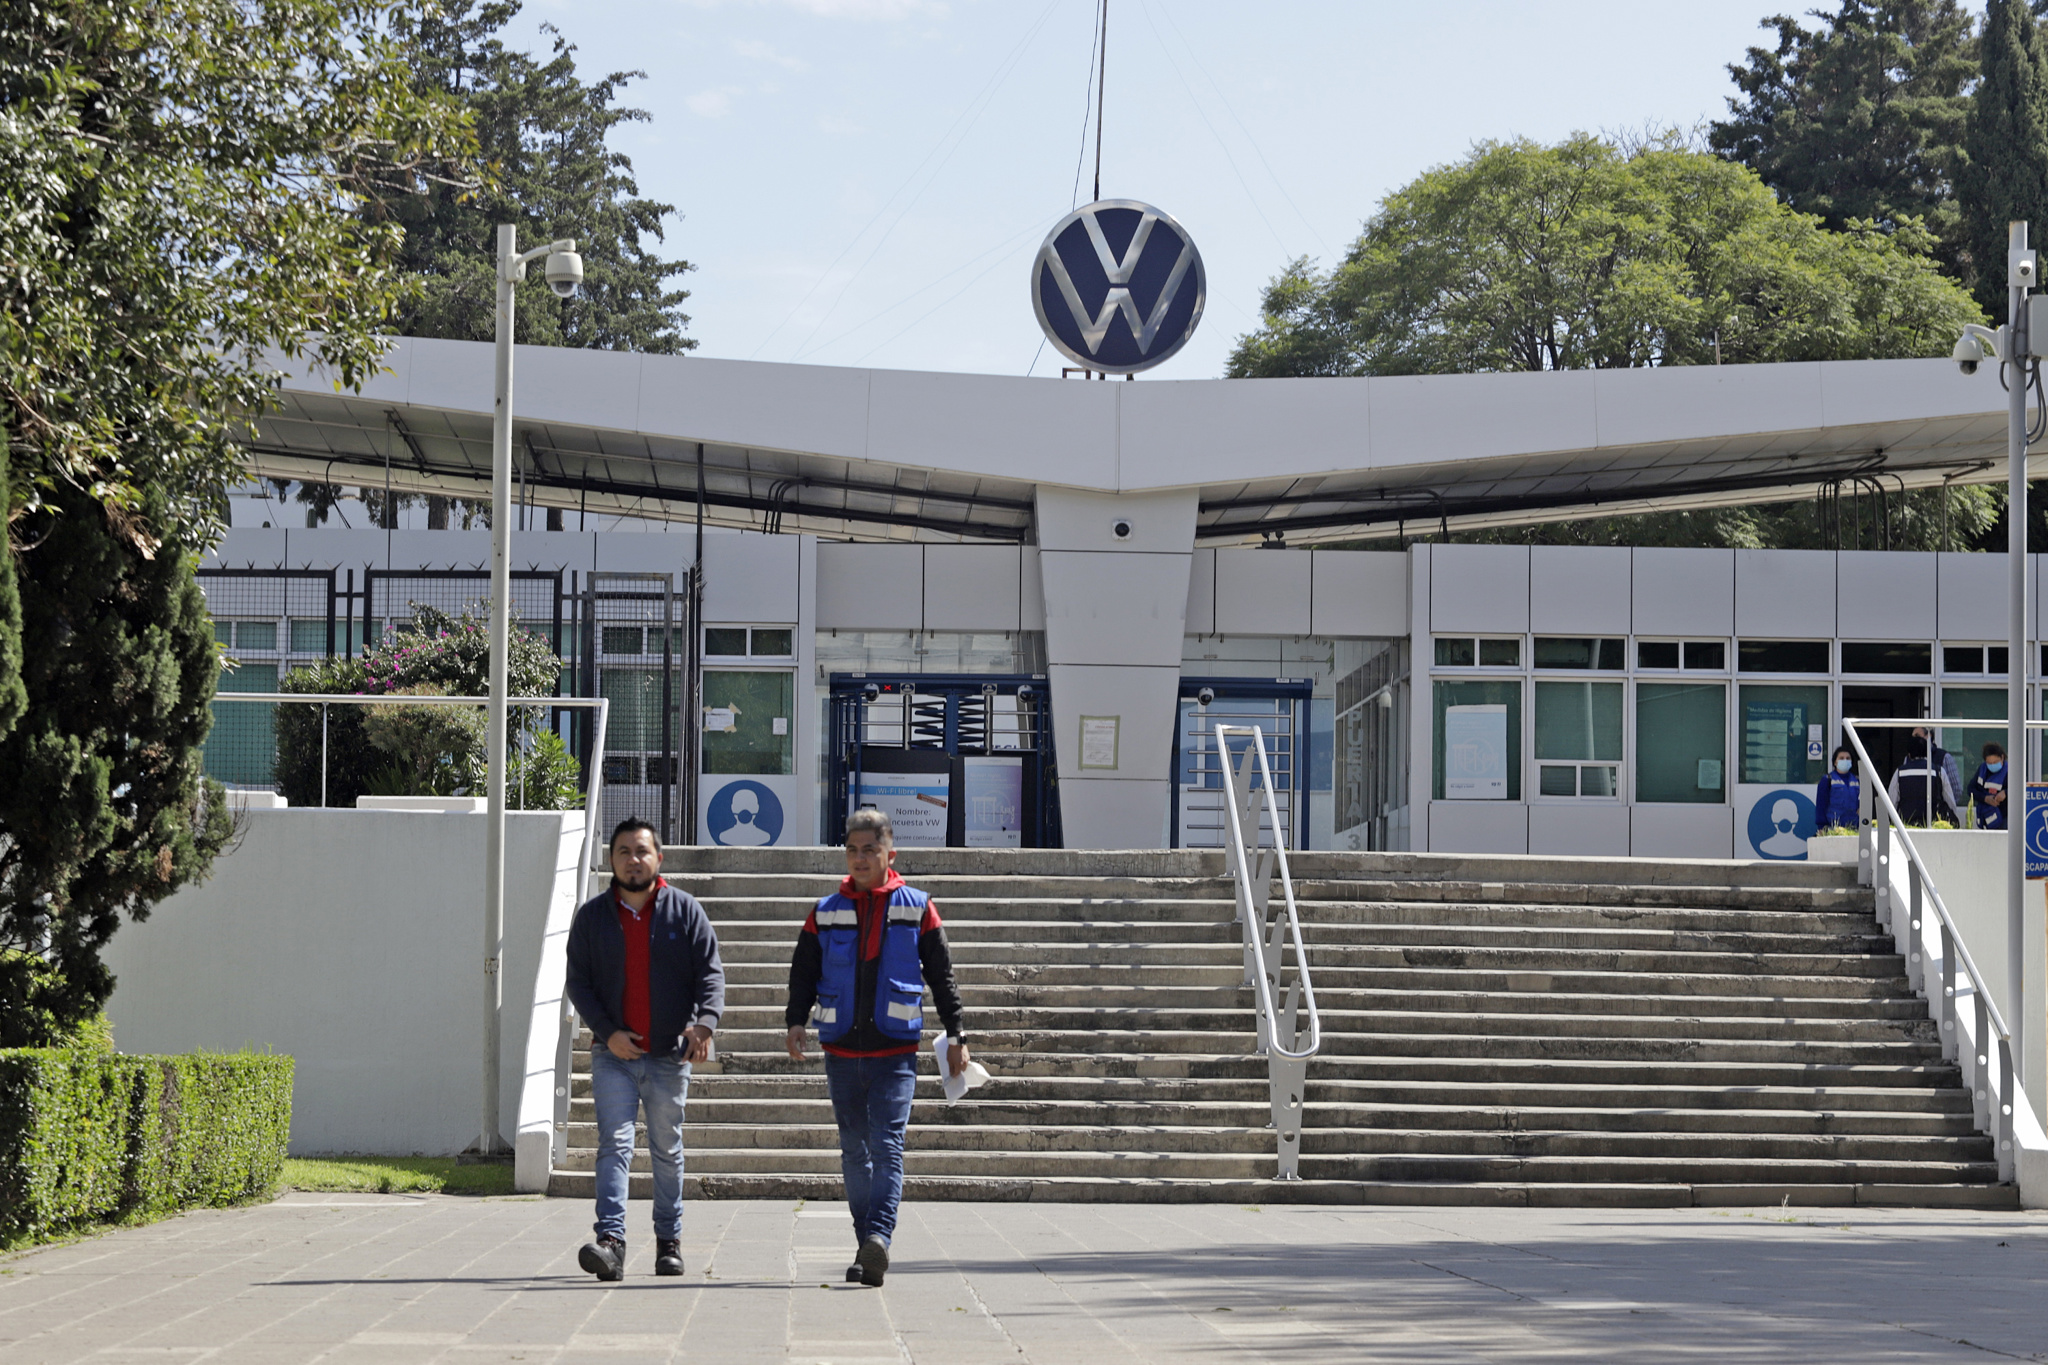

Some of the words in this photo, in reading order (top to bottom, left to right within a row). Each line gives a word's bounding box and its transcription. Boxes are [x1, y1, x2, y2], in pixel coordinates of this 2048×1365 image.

[1036, 202, 1202, 366] VW
[1347, 710, 1364, 818] PUERTA
[2026, 791, 2048, 800] ELEV
[895, 808, 931, 816] Nombre:
[1348, 834, 1361, 851] 3
